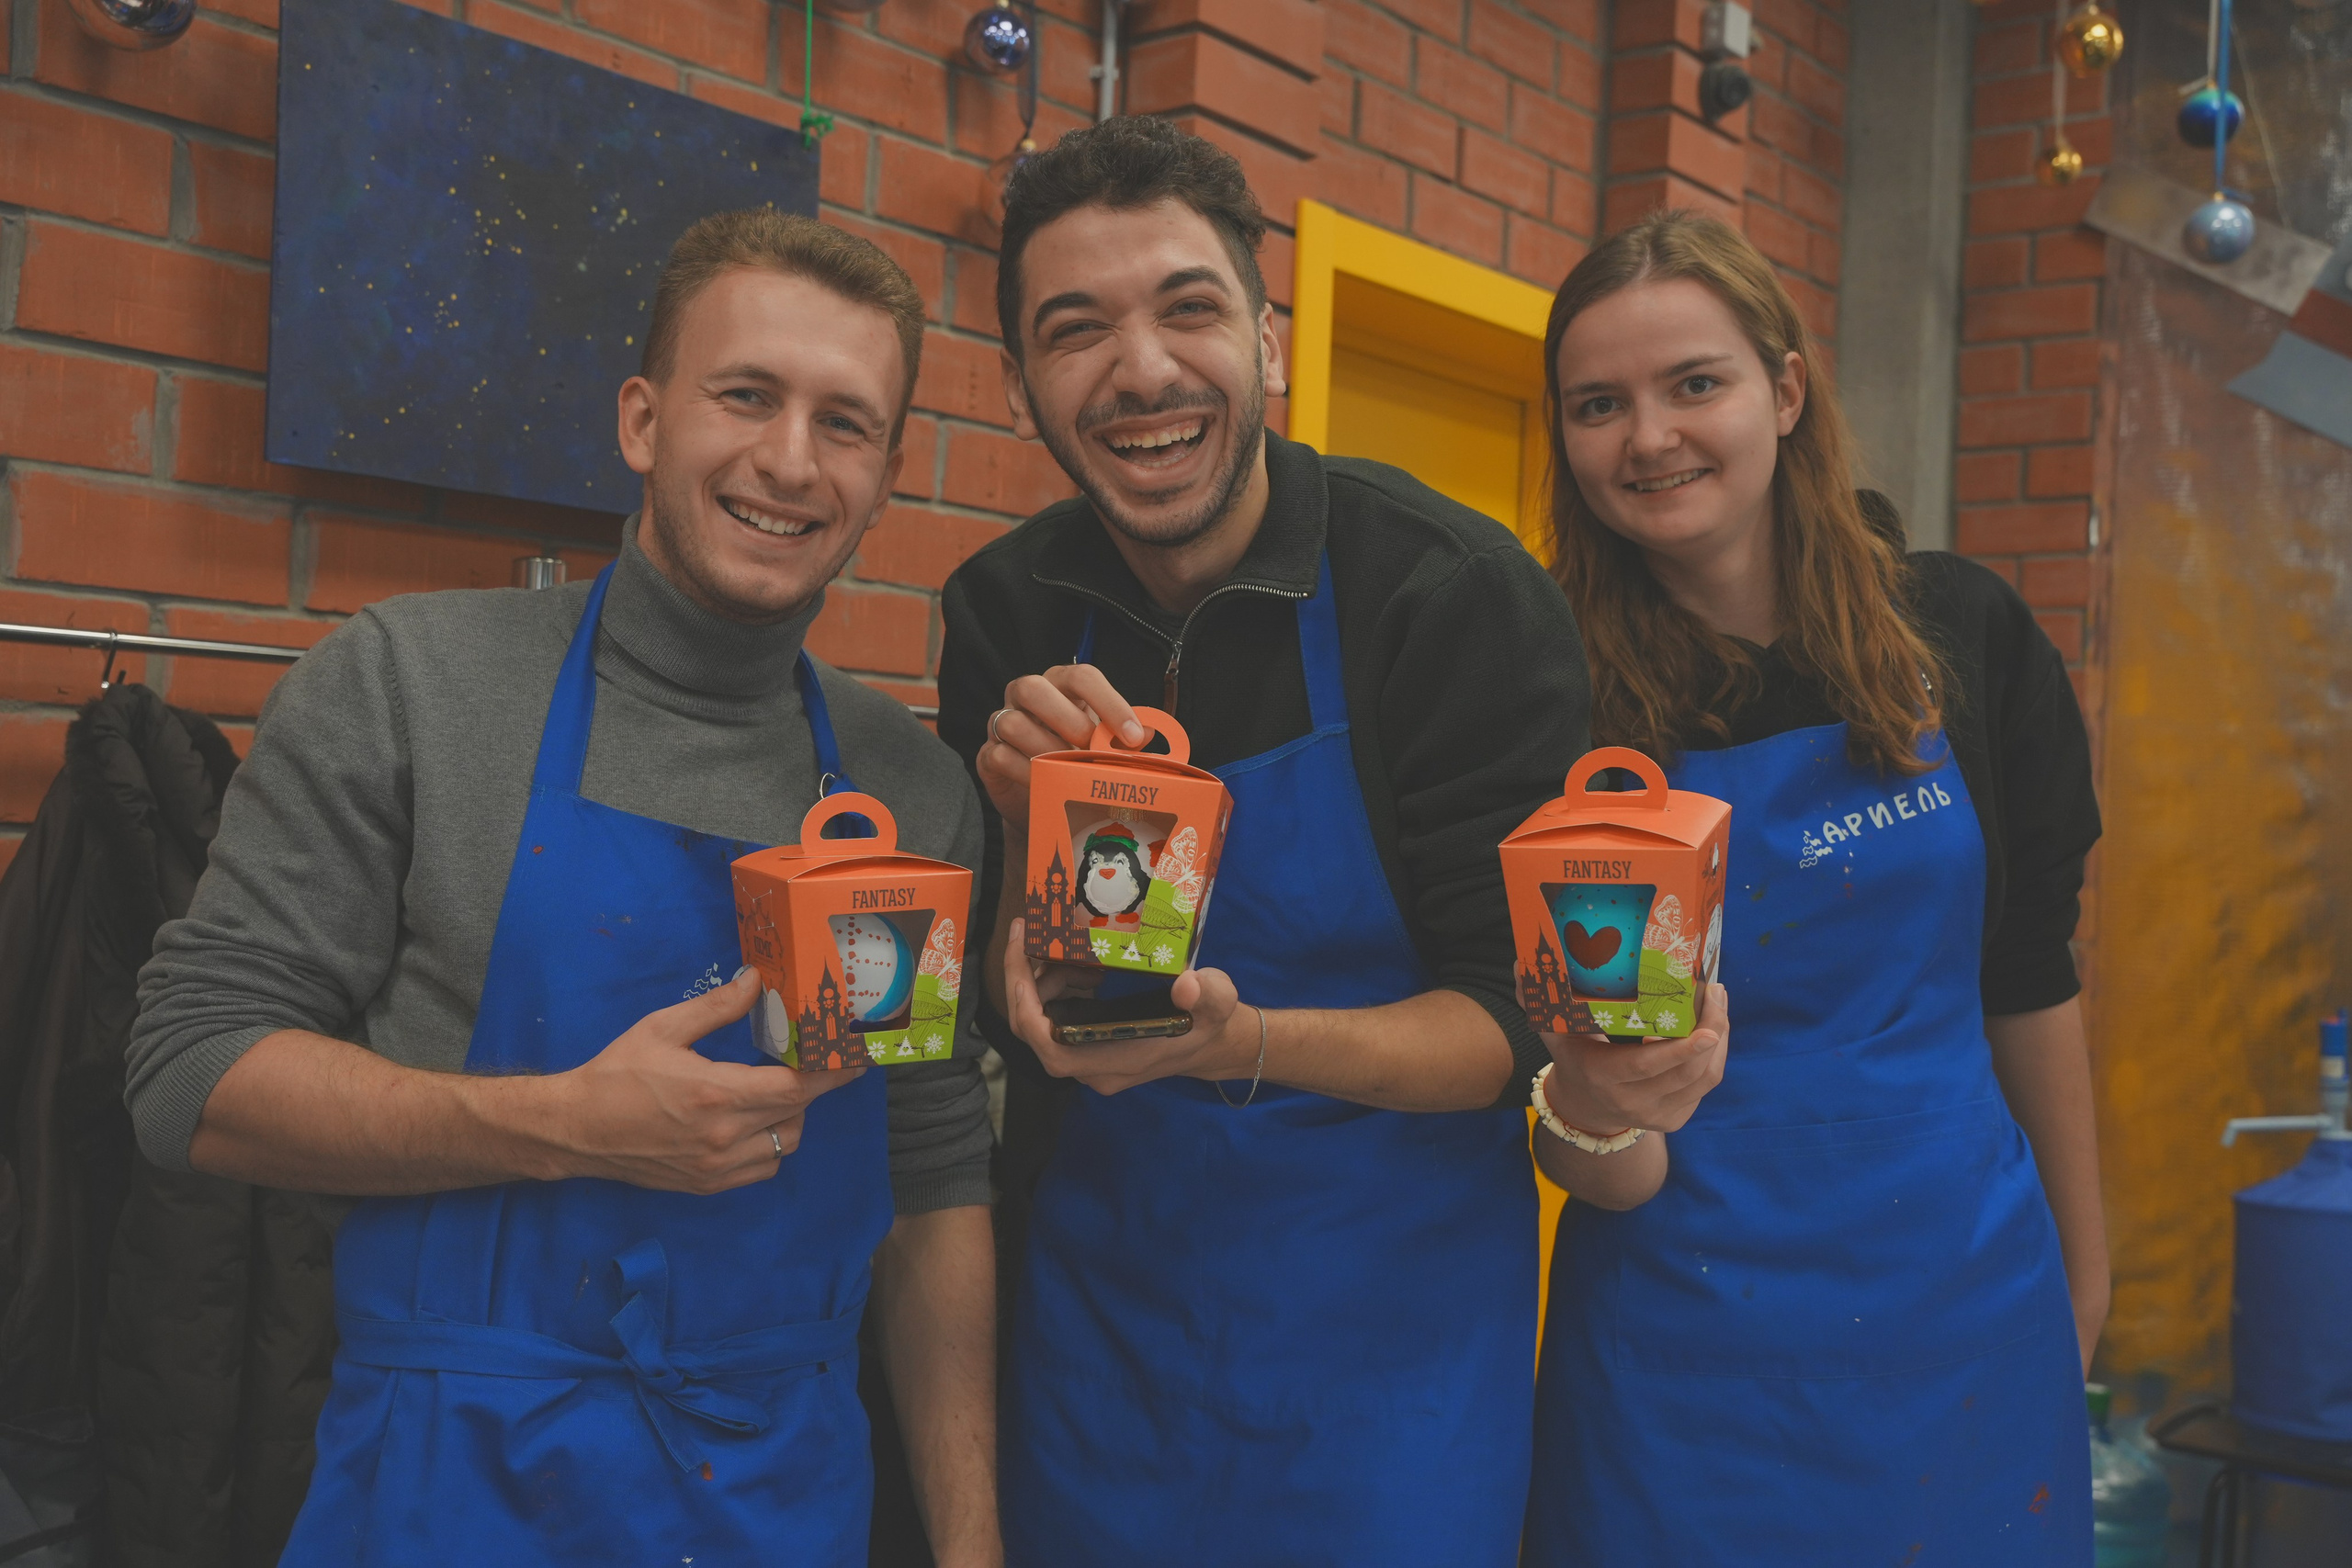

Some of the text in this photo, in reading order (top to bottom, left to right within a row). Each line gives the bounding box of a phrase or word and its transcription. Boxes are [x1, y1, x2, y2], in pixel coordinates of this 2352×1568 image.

[1091, 780, 1159, 806] FANTASY
[1823, 783, 1951, 844] АРИЕЛЬ
[1563, 860, 1632, 879] FANTASY
[853, 887, 916, 908] FANTASY
